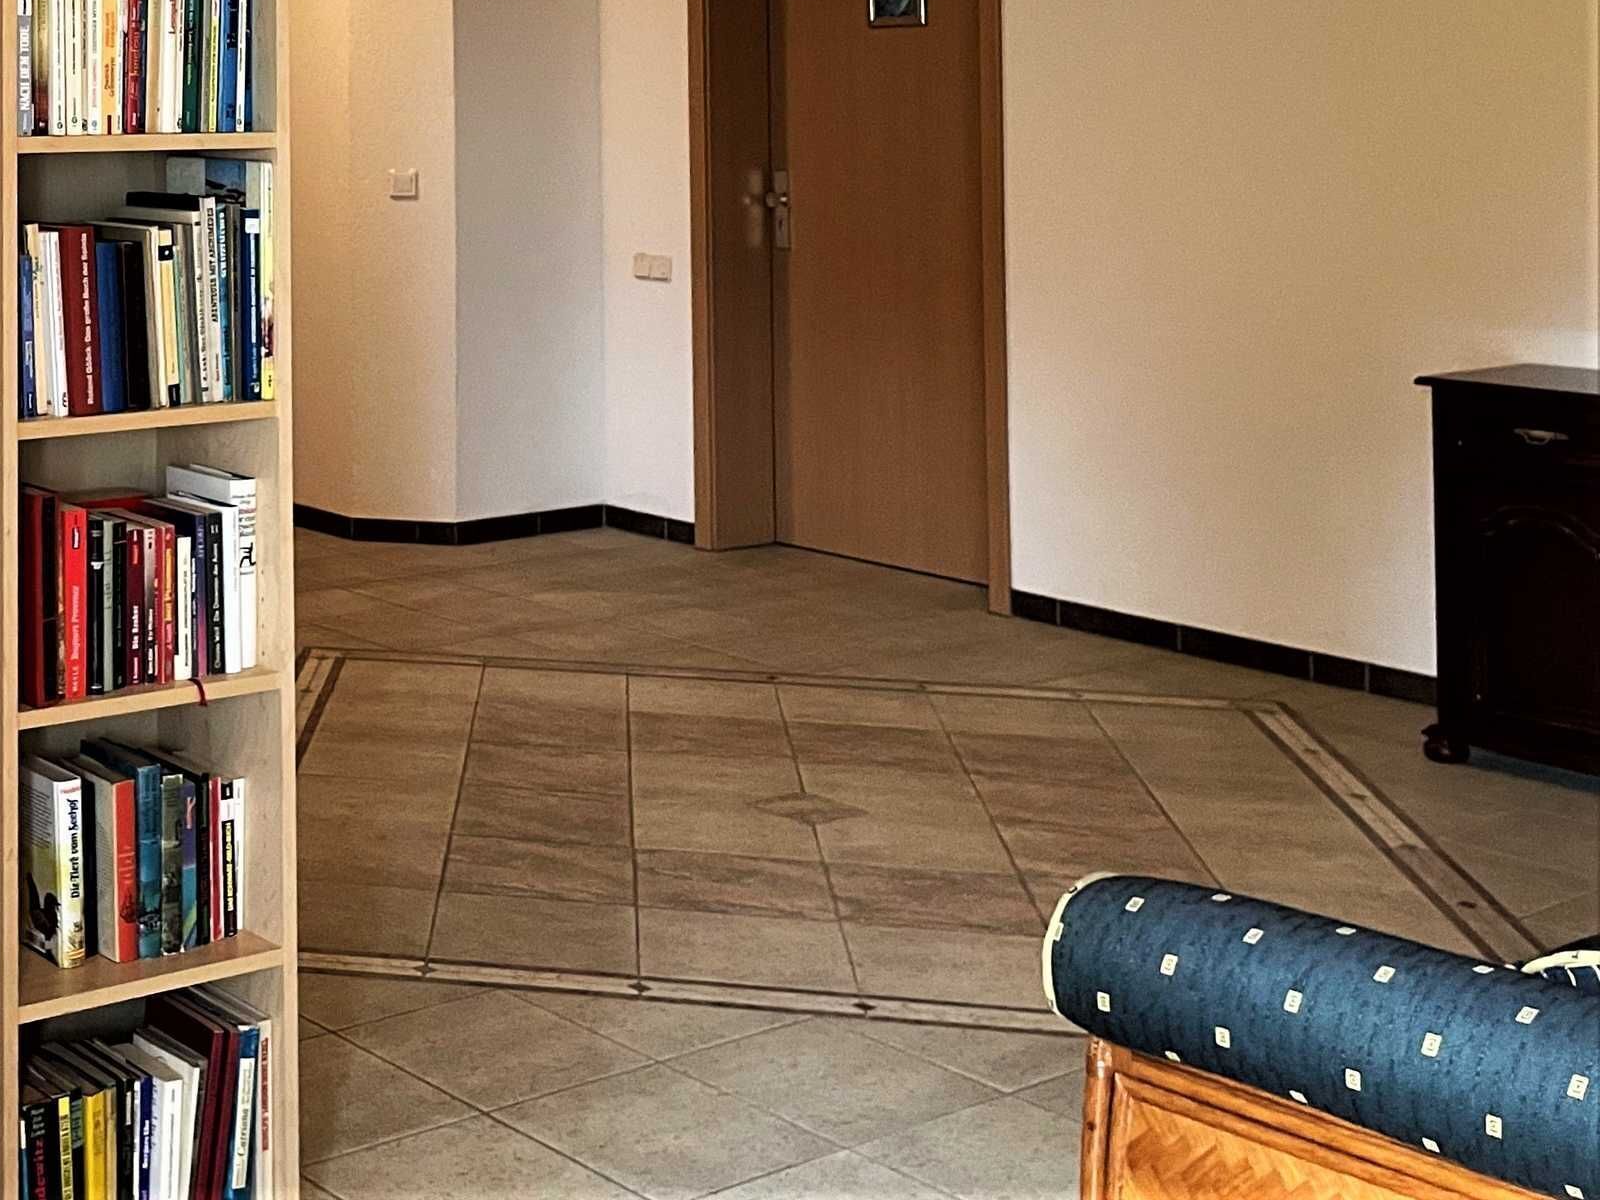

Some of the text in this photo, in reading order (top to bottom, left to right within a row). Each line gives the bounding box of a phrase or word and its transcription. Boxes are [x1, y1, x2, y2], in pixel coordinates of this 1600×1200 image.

[19, 25, 31, 111] NACH DEM TODE
[66, 798, 81, 899] Die Tiere vom Seehof
